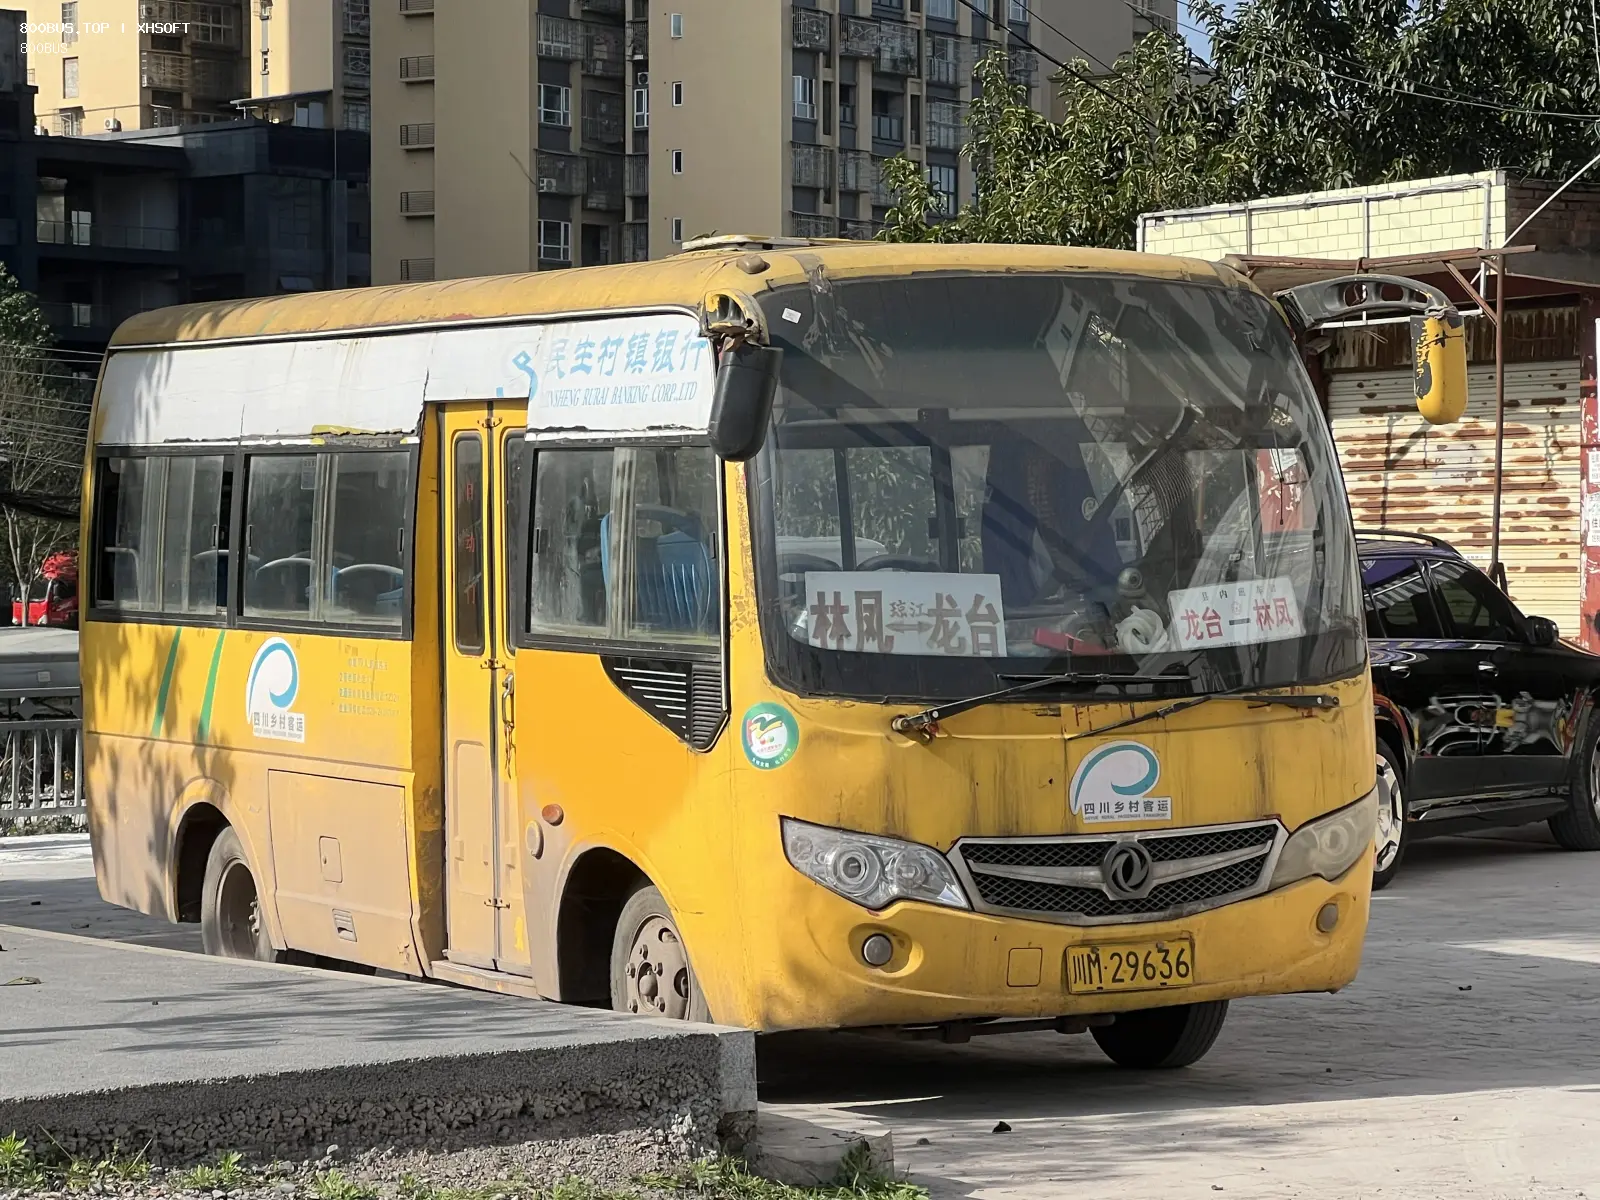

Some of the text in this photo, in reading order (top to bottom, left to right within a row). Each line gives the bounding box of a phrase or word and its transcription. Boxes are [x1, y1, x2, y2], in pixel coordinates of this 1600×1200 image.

[544, 329, 709, 380] 民生村镇银行
[611, 384, 650, 403] BANKING
[810, 591, 1001, 658] 林凤 龙台
[254, 712, 303, 732] 四川乡村客运
[1084, 800, 1169, 815] 四川乡村客运
